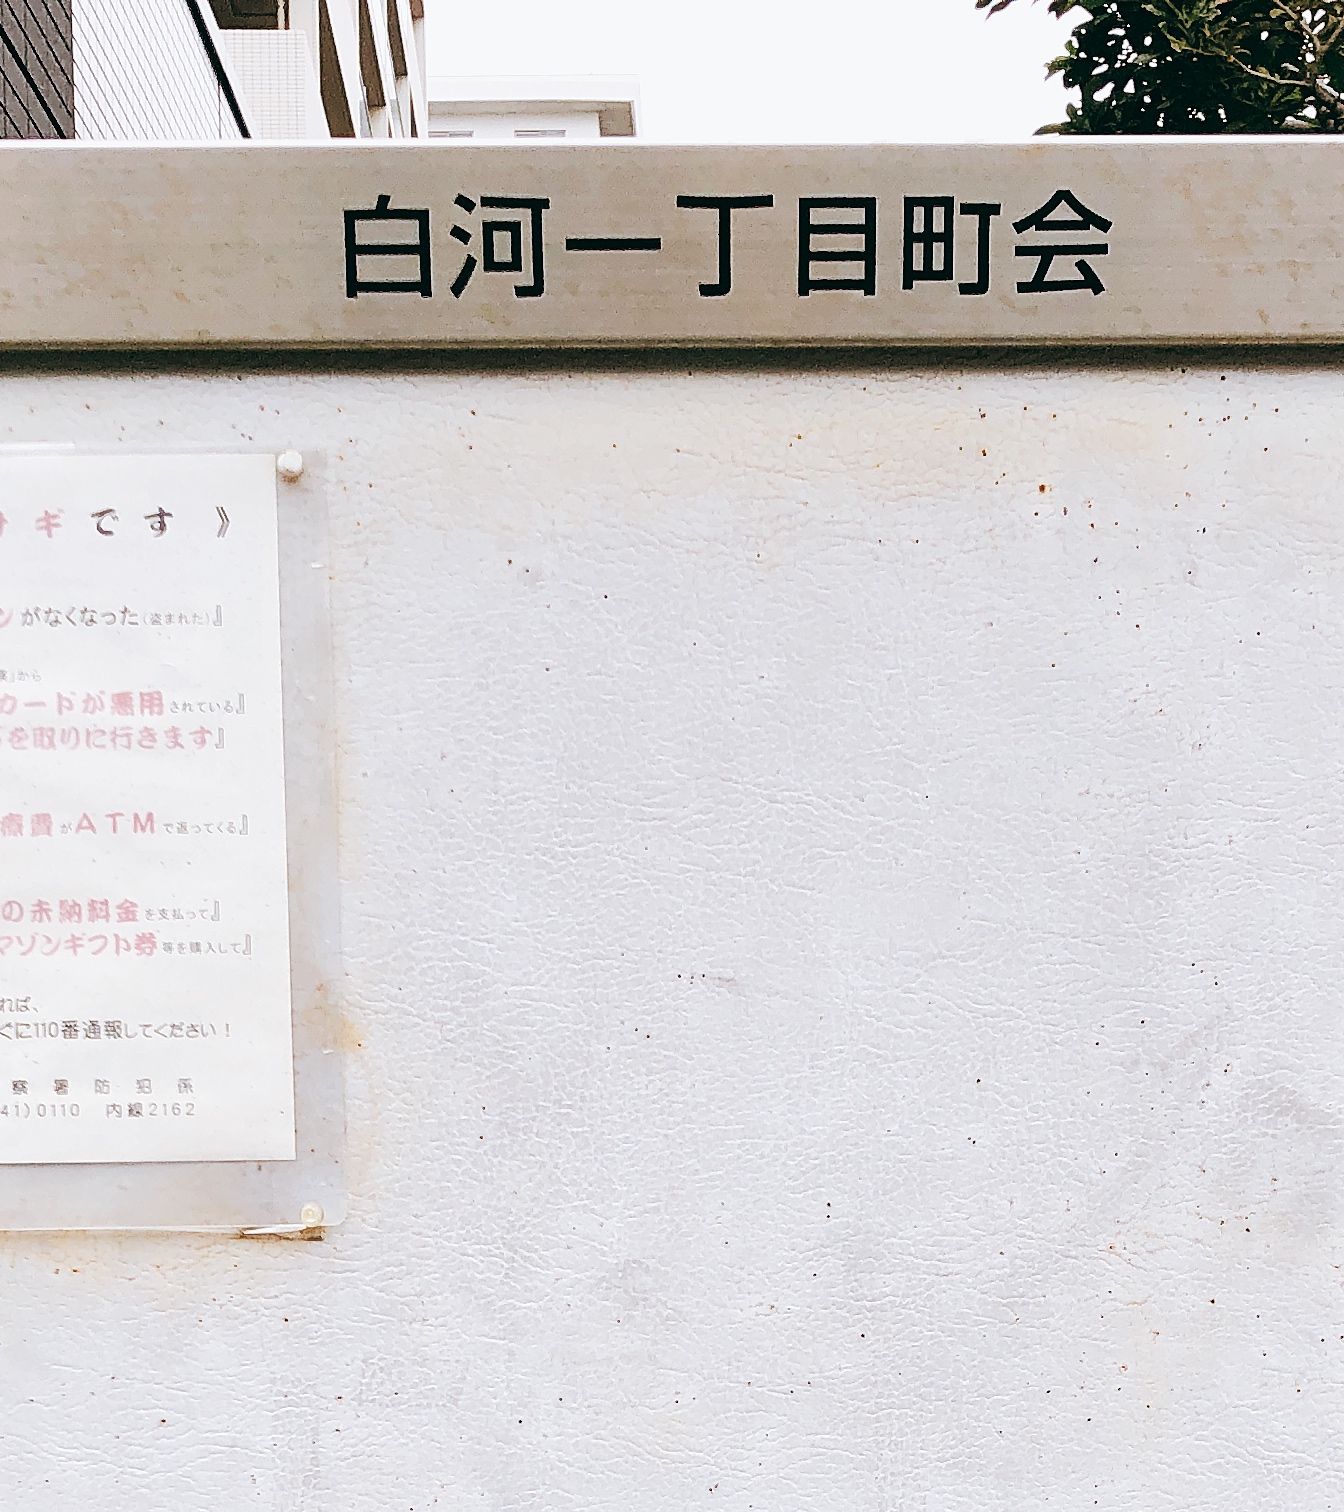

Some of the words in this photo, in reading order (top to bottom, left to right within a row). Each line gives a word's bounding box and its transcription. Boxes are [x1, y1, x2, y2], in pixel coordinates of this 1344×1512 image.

[344, 189, 1113, 298] 白河一丁目町会
